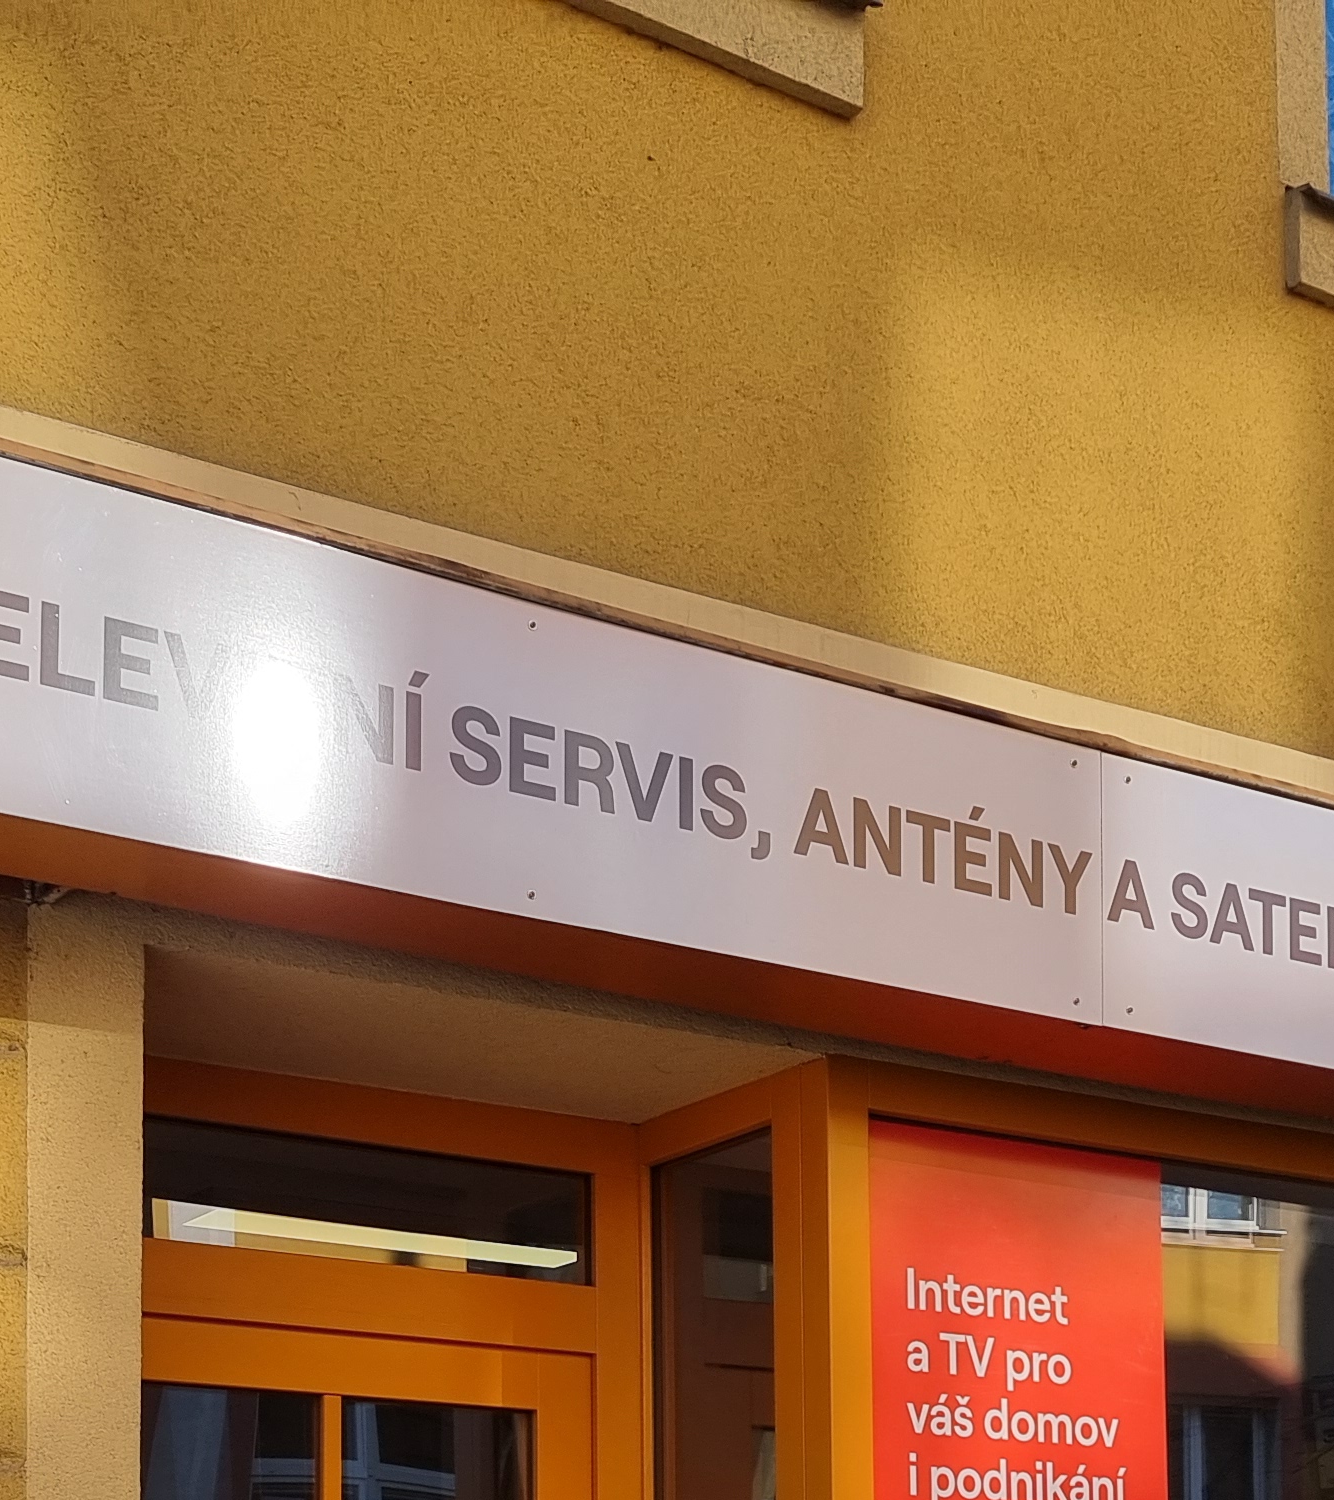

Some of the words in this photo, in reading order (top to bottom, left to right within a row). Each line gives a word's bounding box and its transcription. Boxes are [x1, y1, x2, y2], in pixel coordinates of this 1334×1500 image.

[448, 705, 772, 861] SERVIS,
[794, 787, 1092, 915] ANTÉNY
[1107, 860, 1154, 930] A
[906, 1267, 1069, 1326] Internet
[906, 1341, 929, 1374] a
[939, 1332, 995, 1378] TV
[1006, 1349, 1072, 1391] pro
[907, 1394, 974, 1438] váš
[984, 1398, 1119, 1448] domov
[909, 1453, 918, 1497] i
